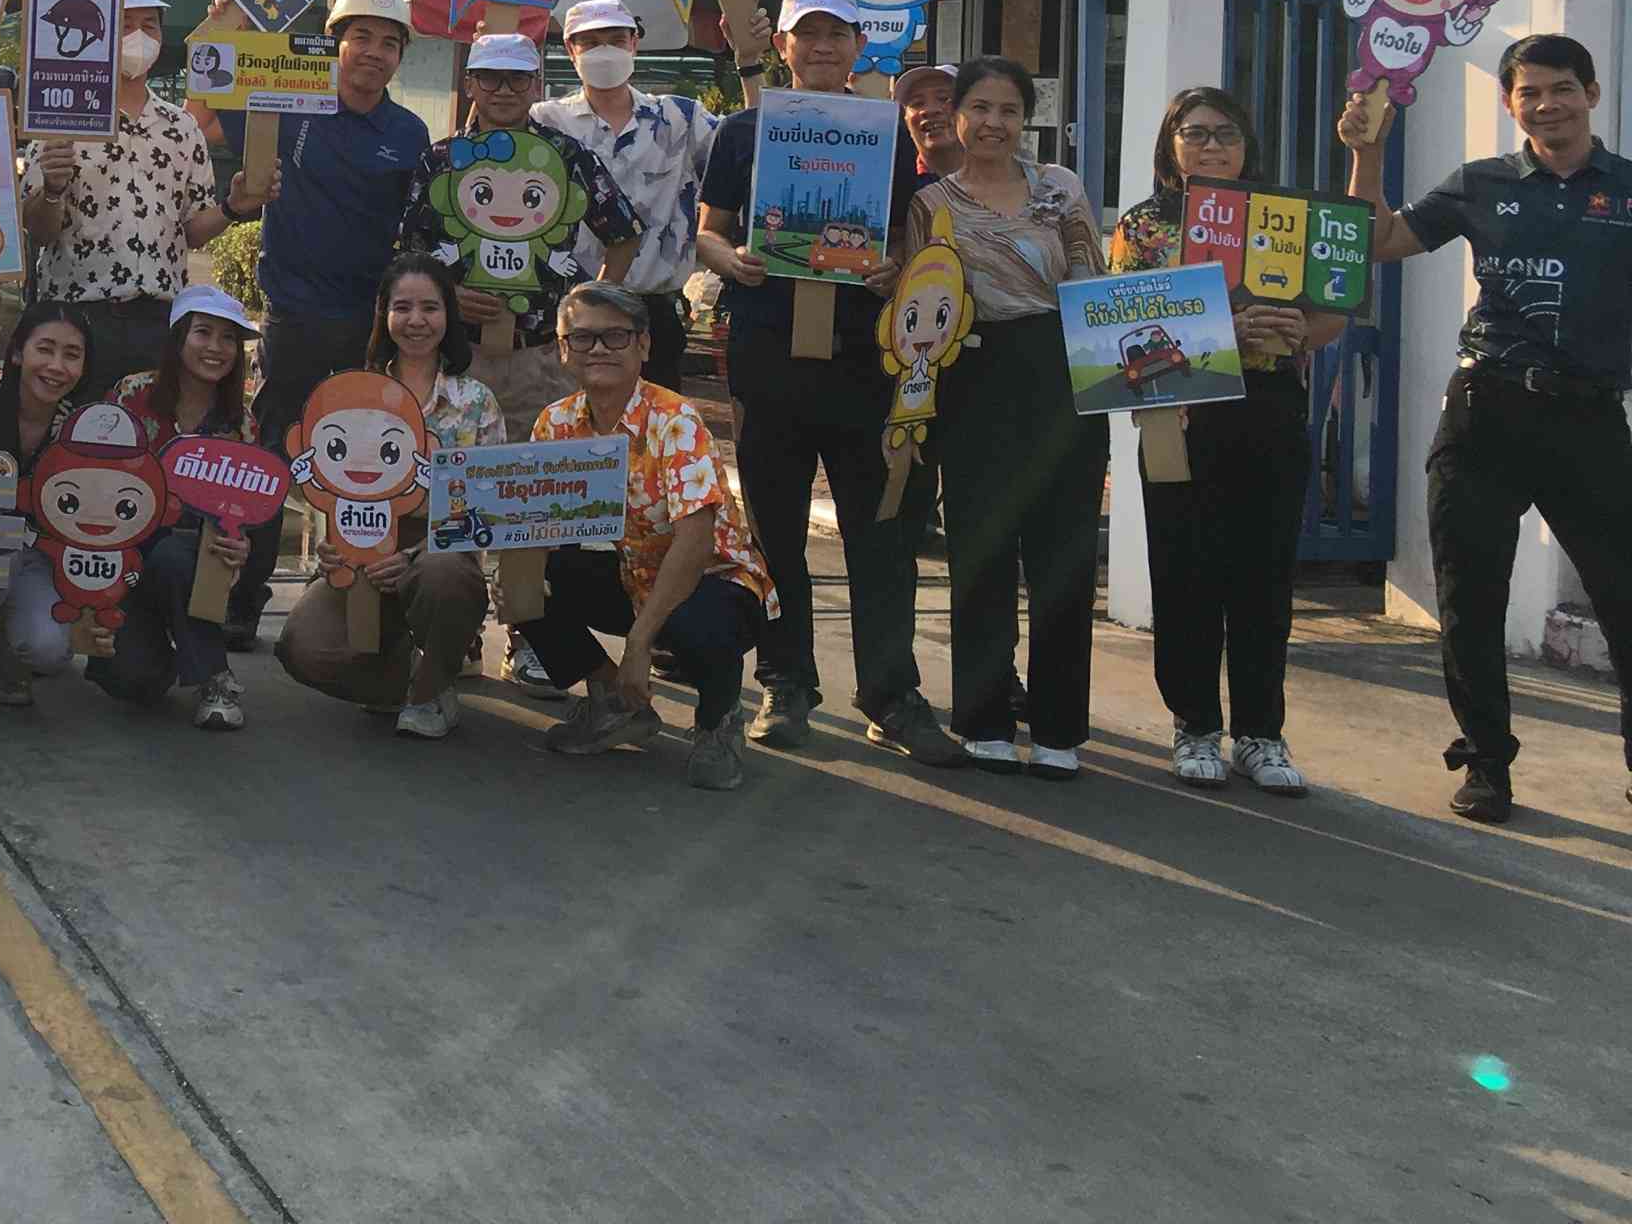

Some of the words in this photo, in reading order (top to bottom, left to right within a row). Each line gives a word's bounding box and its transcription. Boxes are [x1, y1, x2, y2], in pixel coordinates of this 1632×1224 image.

[862, 20, 904, 33] คารพ
[1373, 27, 1423, 55] ห่วงใย
[41, 88, 74, 108] 100
[84, 89, 101, 110] %
[768, 122, 879, 146] ขับขี่ปลอดภัย
[1199, 192, 1234, 225] ดื่ม
[1258, 206, 1296, 233] ง่วง
[1208, 227, 1241, 248] ไม่ขับ
[1319, 209, 1358, 241] โทร
[486, 244, 524, 271] น้ำใจ
[1270, 236, 1302, 256] ไม่ขับ
[1331, 244, 1365, 264] ไม่ขับ
[1084, 294, 1205, 327] ก็ยังไม่ได้ใจเธอ
[174, 446, 280, 496] ดื่มไม่ขับ
[340, 504, 387, 528] สำนึก
[69, 554, 116, 579] วินัย
